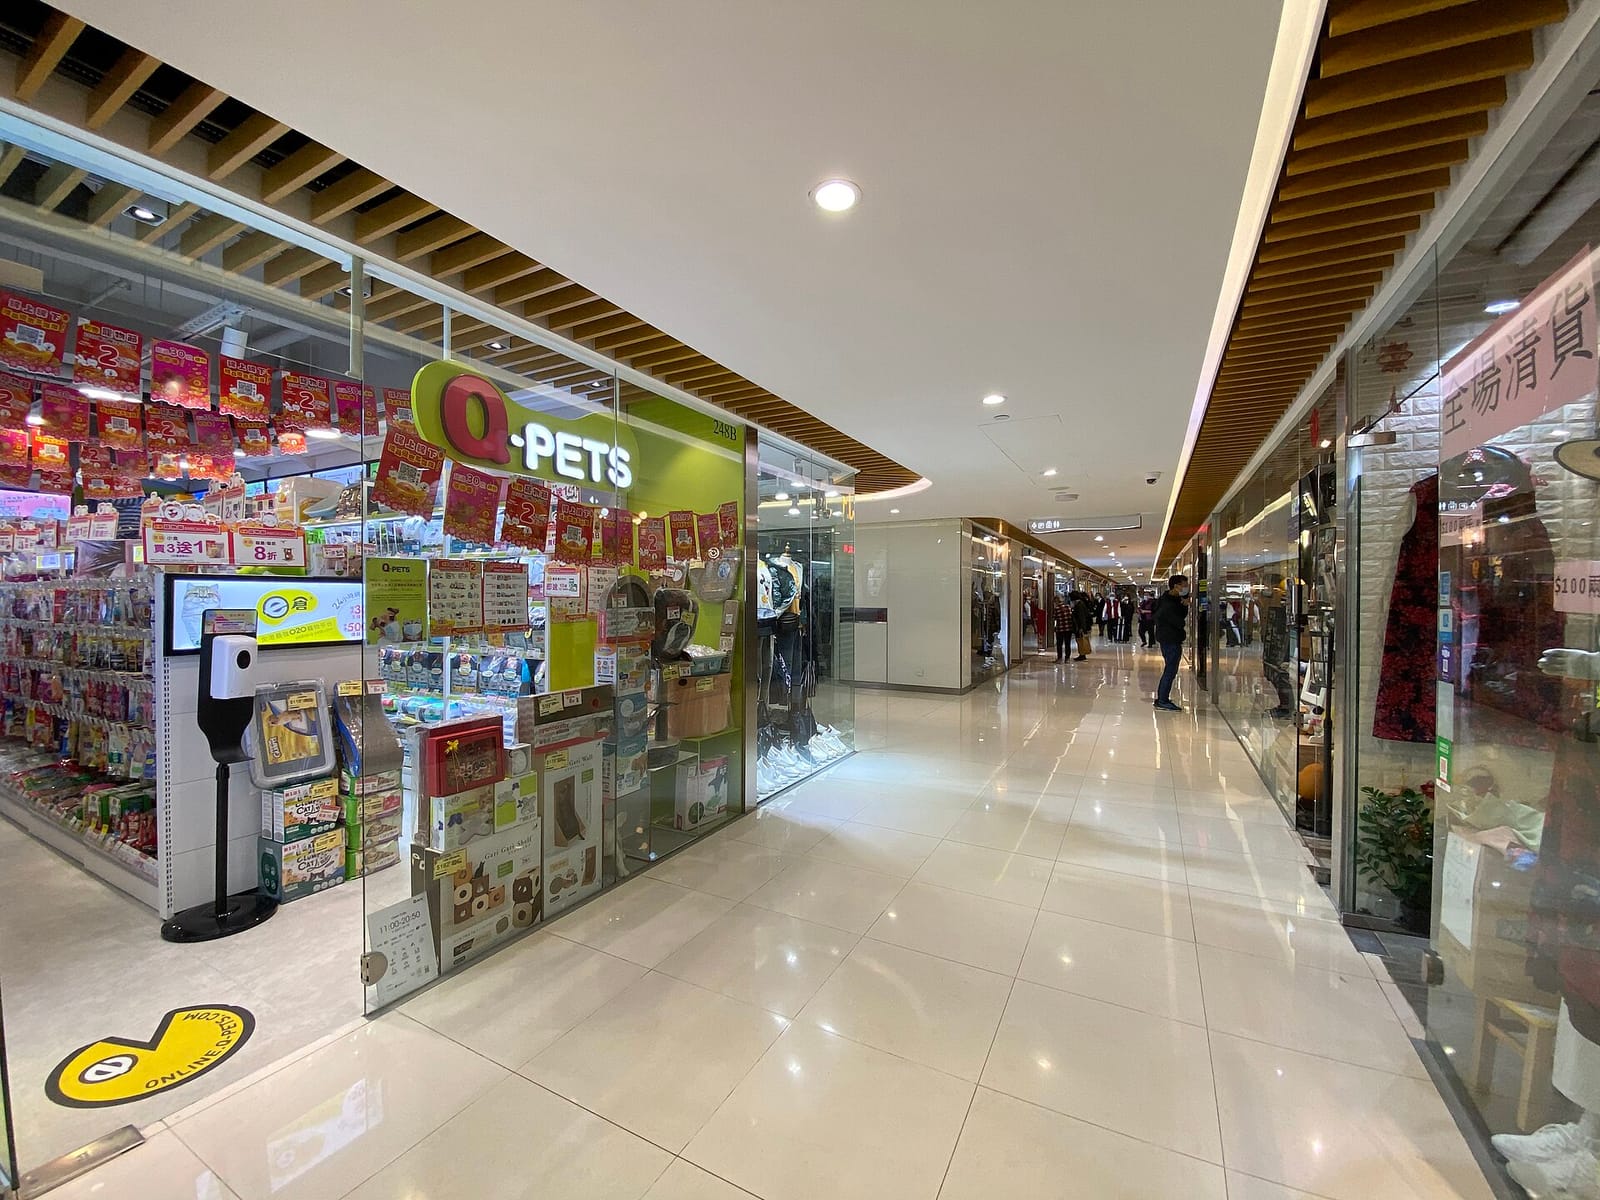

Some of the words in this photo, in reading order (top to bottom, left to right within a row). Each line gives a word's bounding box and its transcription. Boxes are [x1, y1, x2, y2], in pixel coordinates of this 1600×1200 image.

[98, 344, 120, 367] 2
[1444, 281, 1593, 435] 全場清貨
[299, 391, 315, 410] 2
[161, 421, 176, 437] 2
[712, 419, 737, 442] 248B
[519, 502, 535, 525] 2
[153, 540, 203, 554] 買3送1
[254, 546, 277, 561] 8折
